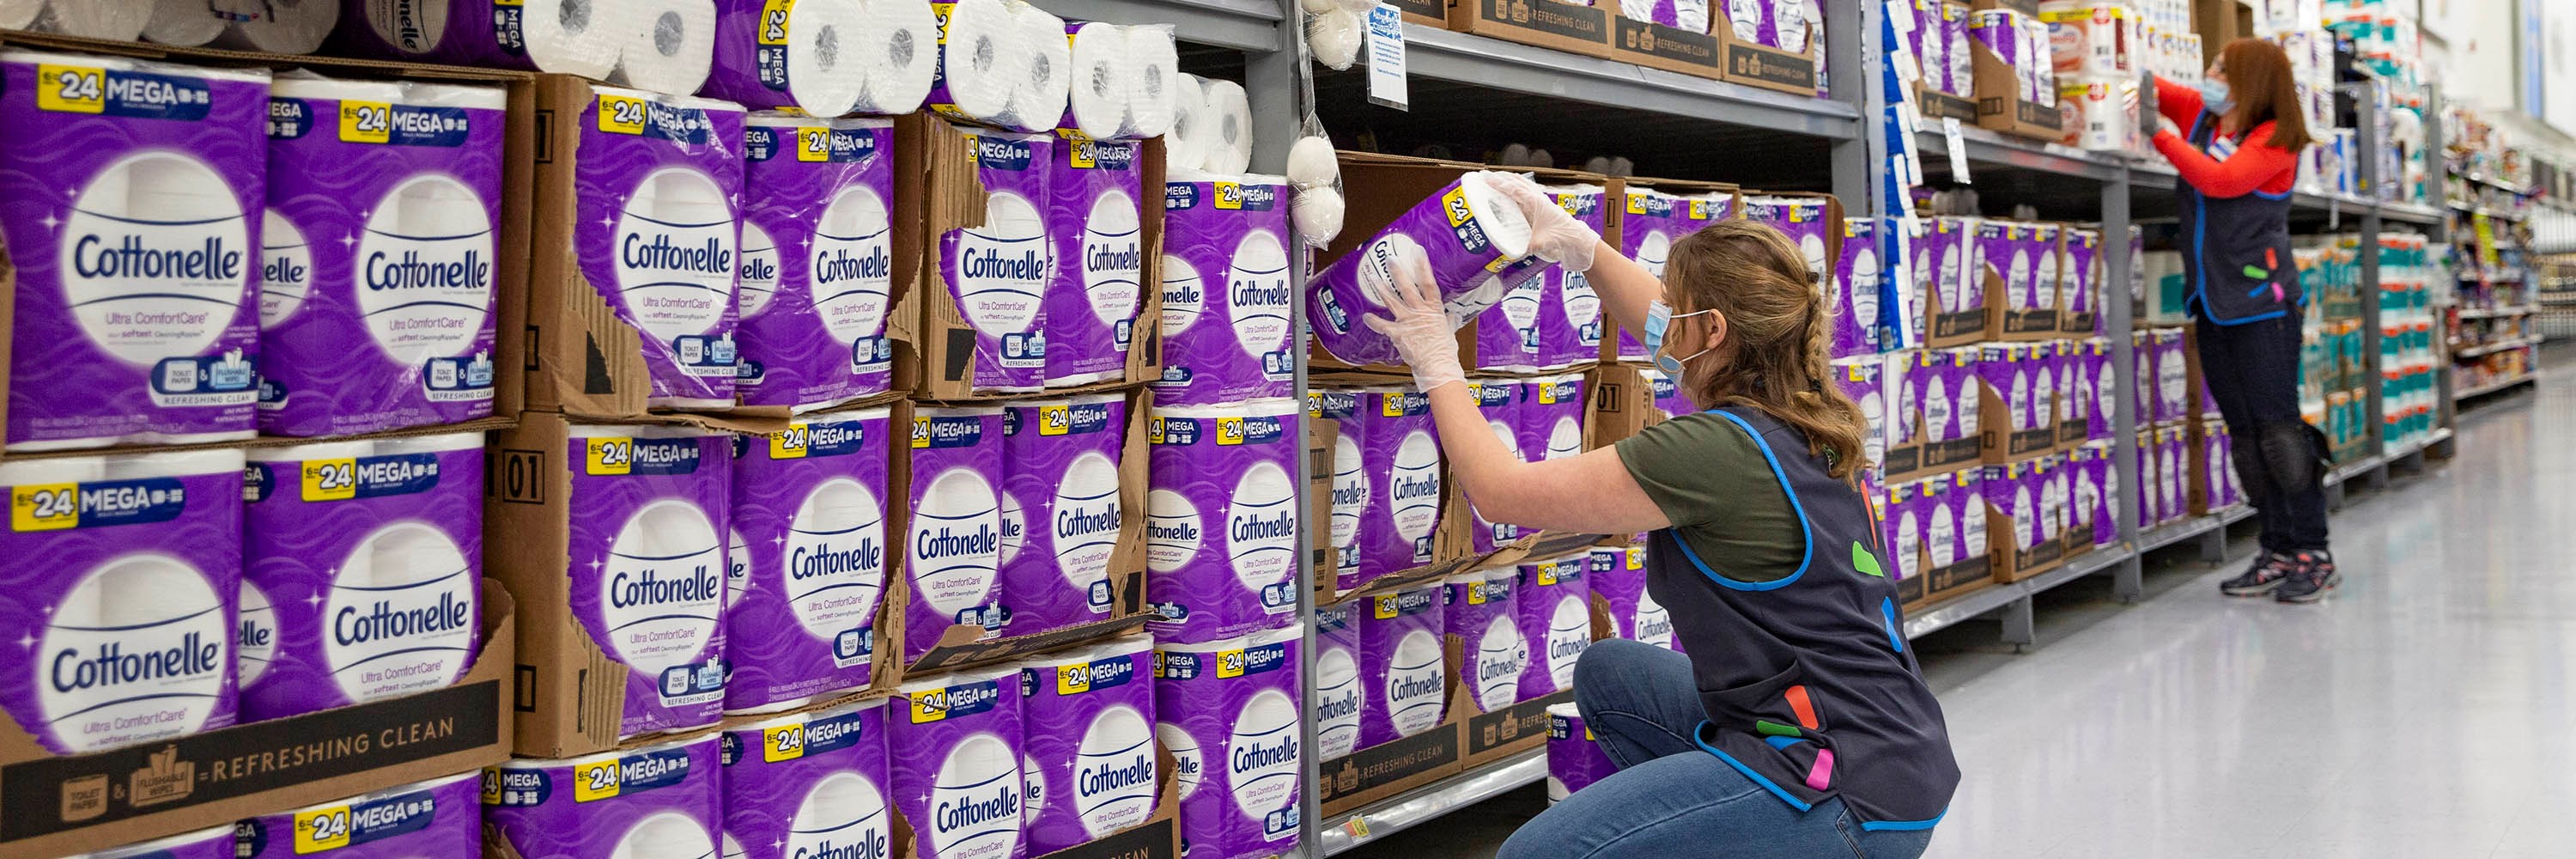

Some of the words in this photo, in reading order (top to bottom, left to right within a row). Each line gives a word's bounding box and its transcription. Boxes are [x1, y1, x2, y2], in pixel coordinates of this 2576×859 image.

[507, 9, 521, 49] MEGA
[767, 10, 787, 41] 24
[1532, 9, 1573, 28] REFRESHING
[1575, 15, 1595, 31] CLEAN
[1657, 39, 1690, 55] REFRESHING
[1692, 45, 1710, 57] CLEAN
[774, 48, 785, 84] MEGA
[60, 71, 101, 101] 24
[106, 78, 178, 105] MEGA
[268, 102, 302, 118] EGA
[356, 107, 386, 131] 24
[392, 112, 443, 133] MEGA
[614, 100, 643, 125] 24
[648, 107, 685, 131] MEGA
[809, 132, 828, 153] 24
[829, 131, 855, 151] MEGA
[979, 143, 1014, 161] MEGA
[1078, 142, 1094, 161] 24
[1166, 186, 1193, 196] MEGA
[1224, 185, 1241, 203] 24
[1241, 188, 1265, 203] MEGA
[1634, 195, 1647, 209] 24
[1564, 197, 1576, 209] 24
[1450, 197, 1469, 221] 24
[1465, 220, 1486, 247] MEGA
[76, 234, 240, 280] Cottonelle
[624, 233, 731, 273] Cottonelle
[963, 247, 1043, 281] Cottonelle
[1087, 243, 1140, 273] Cottonelle
[367, 250, 488, 291] Cottonelle
[817, 246, 888, 284] Cottonelle
[643, 297, 659, 308] Ultra
[660, 298, 710, 309] ComfortCare
[1233, 280, 1289, 308] Cottonelle
[978, 302, 990, 311] Ultra
[106, 312, 131, 326] Ultra
[135, 312, 205, 326] ComfortCare
[407, 318, 464, 330] ComfortCare
[704, 345, 711, 356] &
[199, 369, 209, 381] &
[459, 370, 466, 380] &
[165, 395, 223, 405] REFRESHING
[226, 393, 251, 403] CLEAN
[1309, 395, 1321, 411] 24
[1322, 394, 1346, 411] MEGA
[1389, 395, 1403, 411] 24
[1403, 393, 1421, 409] MEGA
[1481, 387, 1502, 399] MEGA
[1545, 386, 1556, 399] 24
[1049, 409, 1067, 428] 24
[1069, 410, 1095, 424] MEGA
[1166, 422, 1194, 431] MEGA
[1225, 420, 1242, 438] 24
[1243, 421, 1268, 436] MEGA
[782, 428, 805, 449] 24
[808, 427, 845, 446] MEGA
[912, 422, 929, 440] 24
[932, 423, 964, 438] MEGA
[602, 442, 629, 465] 24
[633, 445, 680, 463] MEGA
[319, 463, 353, 490] 24
[357, 461, 412, 484] MEGA
[507, 454, 538, 500] 01
[1394, 473, 1438, 501] Cottonelle
[33, 490, 76, 518] 24
[81, 487, 150, 514] MEGA
[1058, 503, 1121, 539] Cottonelle
[1232, 510, 1294, 543] Cottonelle
[917, 523, 997, 560] Cottonelle
[792, 536, 880, 580] Cottonelle
[1590, 554, 1613, 563] MEGA
[933, 581, 945, 590] Ultra
[947, 576, 981, 588] ComfortCare
[1545, 566, 1557, 580] 24
[1557, 564, 1574, 577] MEGA
[611, 564, 718, 609] Cottonelle
[1474, 585, 1485, 599] 24
[808, 602, 823, 612] Ultra
[1382, 596, 1397, 612] 24
[1398, 595, 1420, 609] MEGA
[336, 591, 468, 647] Cottonelle
[1316, 612, 1337, 626] MEGA
[630, 633, 647, 644] Ultra
[649, 629, 696, 642] ComfortCare
[52, 631, 218, 693] Cottonelle
[1167, 656, 1194, 666] MEGA
[1226, 652, 1243, 670] 24
[1245, 649, 1271, 664] MEGA
[1480, 650, 1517, 683] Cottonelle
[361, 673, 383, 685] Ultra
[386, 662, 441, 680] ComfortCare
[690, 674, 697, 685] &
[1068, 667, 1089, 685] 24
[1091, 662, 1118, 681] MEGA
[1391, 670, 1443, 703] Cottonelle
[667, 694, 707, 706] REFRESHING
[708, 691, 723, 701] CLEAN
[923, 693, 944, 714] 24
[947, 688, 980, 707] MEGA
[83, 722, 112, 735] Ultra
[114, 710, 185, 730] ComfortCare
[777, 728, 801, 752] 24
[804, 722, 842, 745] MEGA
[213, 734, 369, 784] REFRESHING
[380, 717, 454, 749] CLEAN
[1234, 735, 1298, 774] Cottonelle
[1363, 752, 1415, 780] REFRESHING
[1417, 743, 1443, 765] CLEAN
[504, 773, 542, 788] MEGA
[589, 765, 617, 791] 24
[622, 758, 667, 783] MEGA
[1080, 754, 1153, 798] Cottonelle
[1246, 789, 1257, 799] Ultra
[937, 786, 1018, 833] Cottonelle
[1095, 813, 1107, 824] Ultra
[1108, 806, 1139, 820] ComfortCare
[313, 811, 347, 841] 24
[352, 802, 408, 832] MEGA
[969, 841, 1004, 857] ComfortCare
